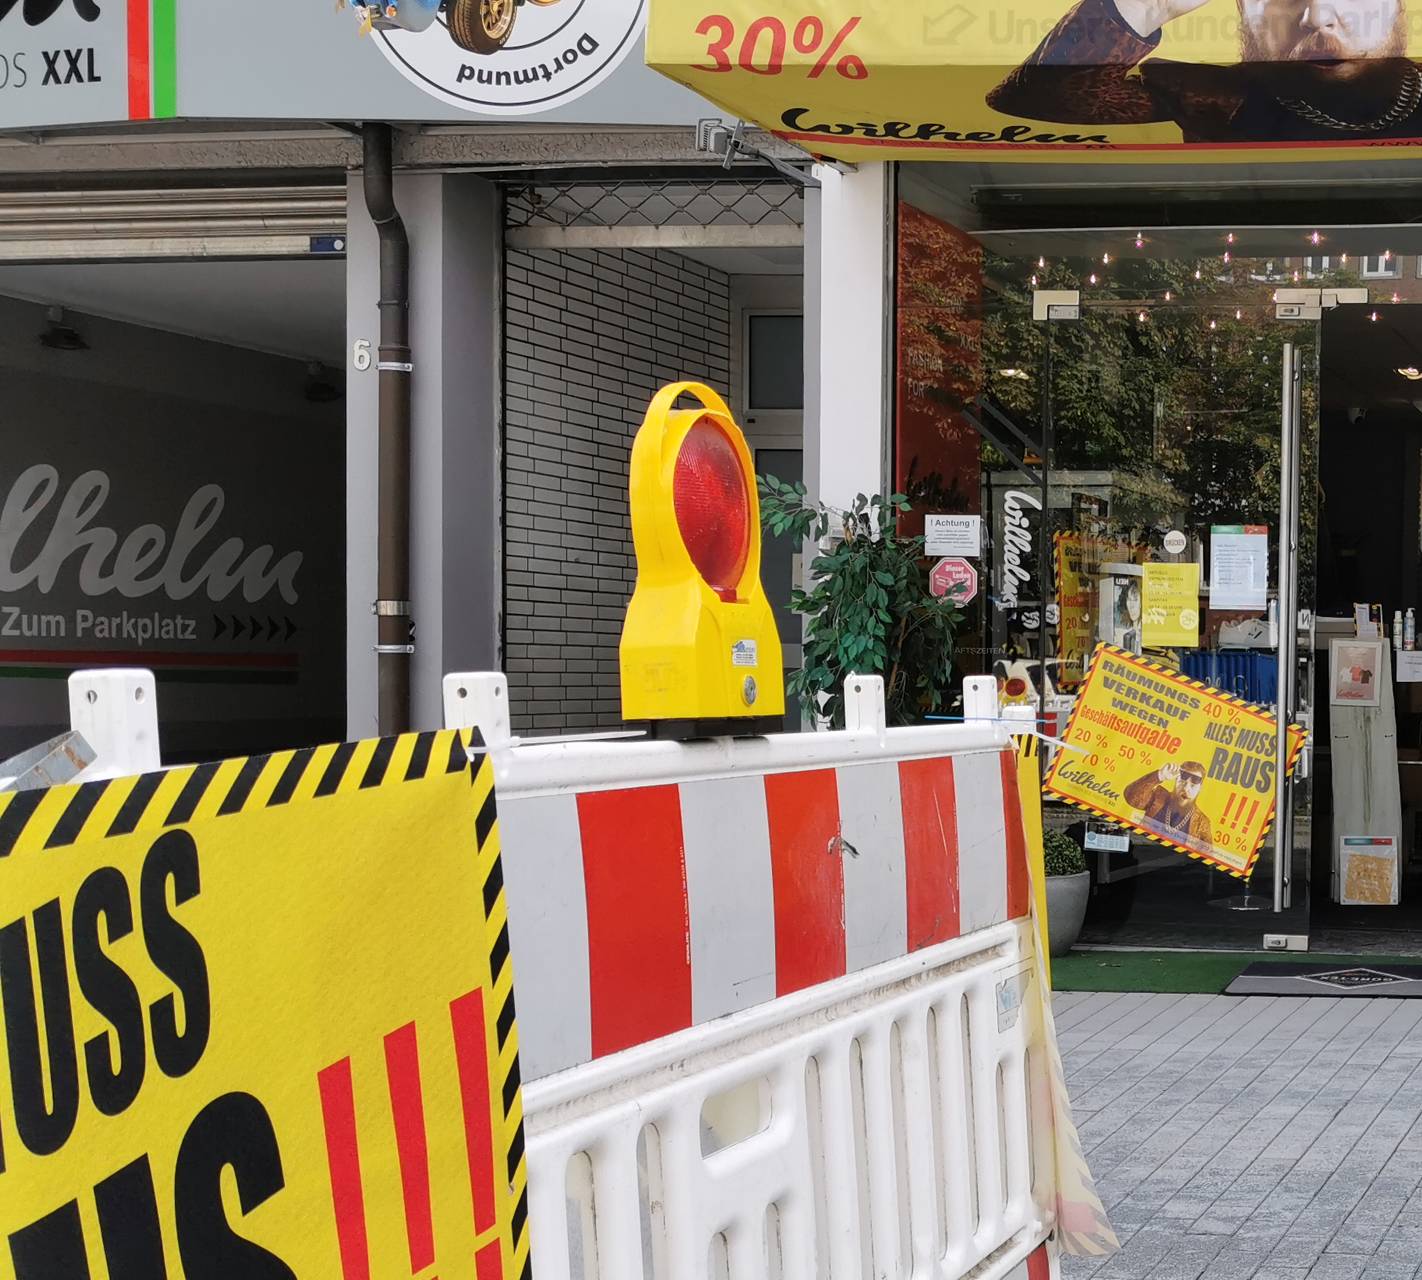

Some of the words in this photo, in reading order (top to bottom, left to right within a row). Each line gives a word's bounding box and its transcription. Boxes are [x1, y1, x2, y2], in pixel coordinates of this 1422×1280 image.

[455, 32, 600, 86] Dortmund
[689, 14, 870, 80] 30%
[41, 48, 101, 86] XXL
[780, 107, 1110, 145] Wilhelm
[353, 339, 372, 372] 6
[935, 519, 970, 528] Achtung
[0, 606, 66, 638] Zum
[75, 609, 197, 641] Parkplatz
[1102, 660, 1200, 709] RÄUMUNGS
[1103, 676, 1192, 722] VERKAUF
[1080, 704, 1183, 755] Geschäftsaufgabe
[1112, 697, 1169, 729] WEGEN
[1202, 702, 1222, 719] 40
[1227, 708, 1241, 726] %
[1074, 728, 1091, 743] 20
[1096, 734, 1108, 749] %
[1118, 744, 1136, 761] 50
[1140, 751, 1152, 766] %
[1203, 721, 1237, 746] ALLES
[1234, 728, 1277, 758] MUSS
[1057, 759, 1121, 801] Wilhelm
[1103, 756, 1116, 773] %
[1207, 746, 1275, 793] RAUS
[1219, 792, 1260, 835] !!!
[1213, 831, 1231, 846] 30
[1235, 837, 1248, 852] %
[0, 828, 210, 1174] USS
